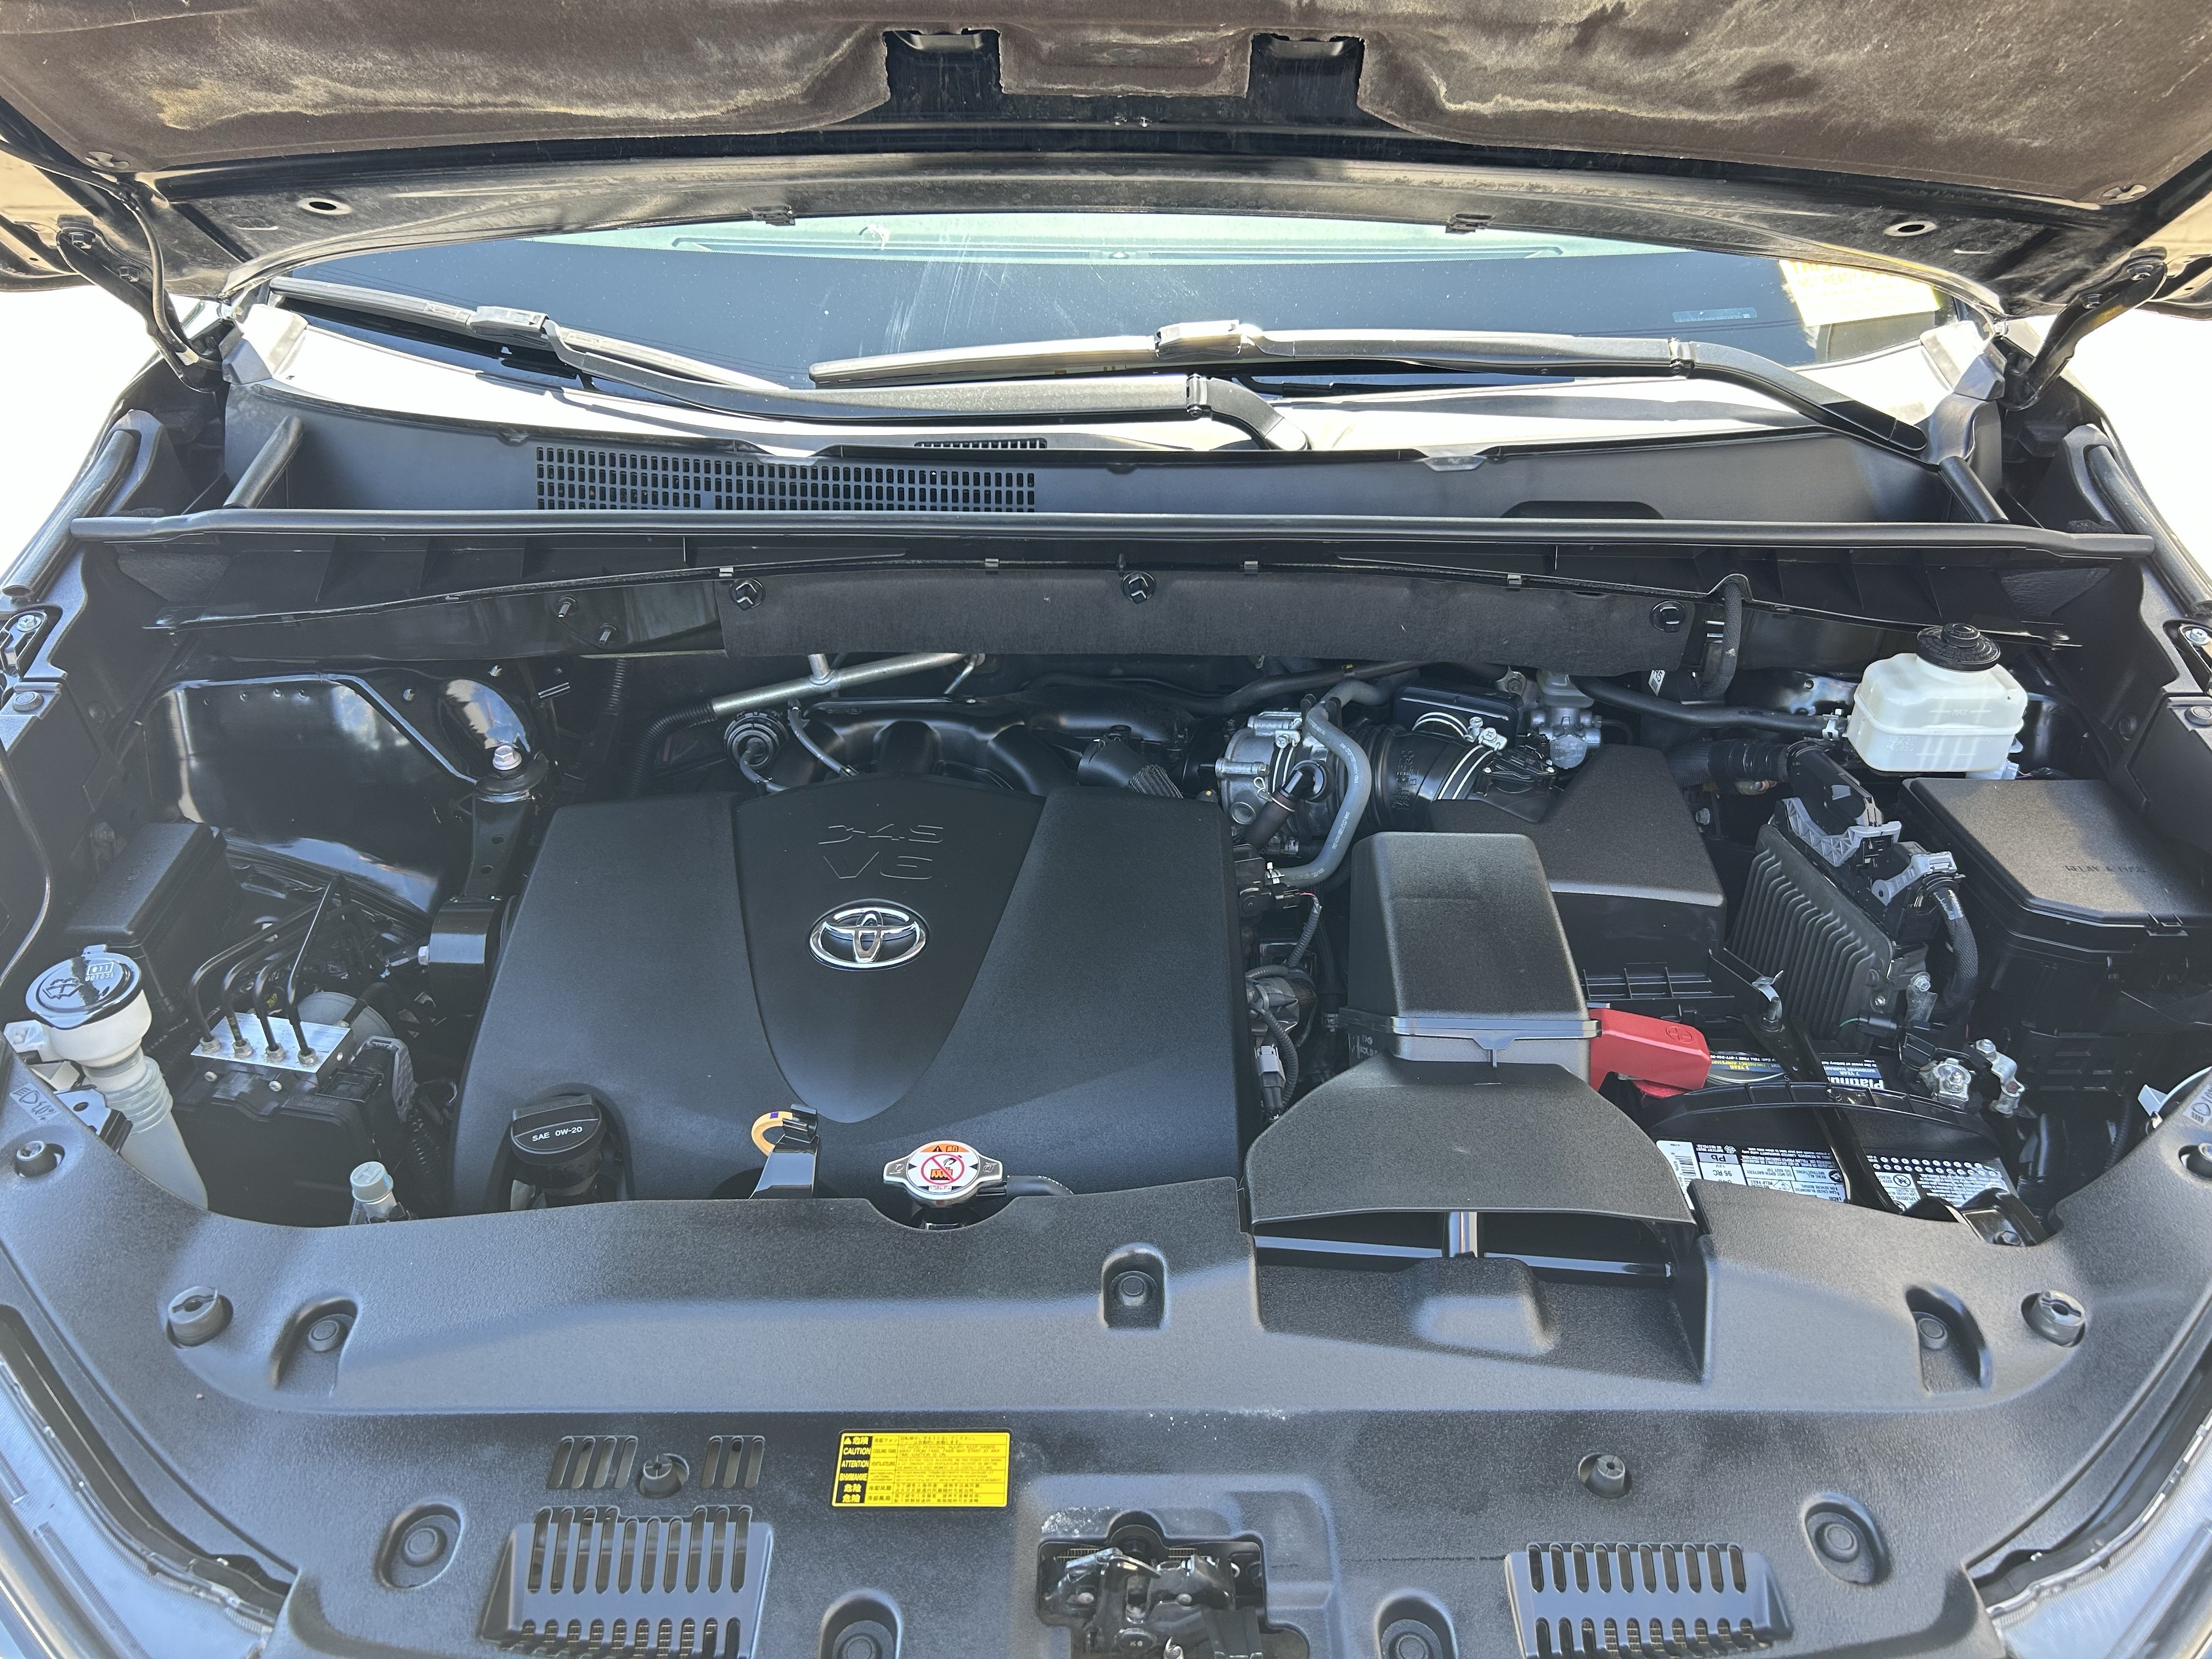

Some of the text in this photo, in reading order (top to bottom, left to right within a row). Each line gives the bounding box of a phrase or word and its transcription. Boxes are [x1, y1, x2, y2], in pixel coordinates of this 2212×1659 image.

[823, 851, 933, 880] V6
[532, 1126, 583, 1142] SAE 0W-20
[843, 1447, 871, 1455] CAUTION
[841, 1460, 870, 1468] ATTENTION
[839, 1472, 868, 1481] ВНИМАНИЕ
